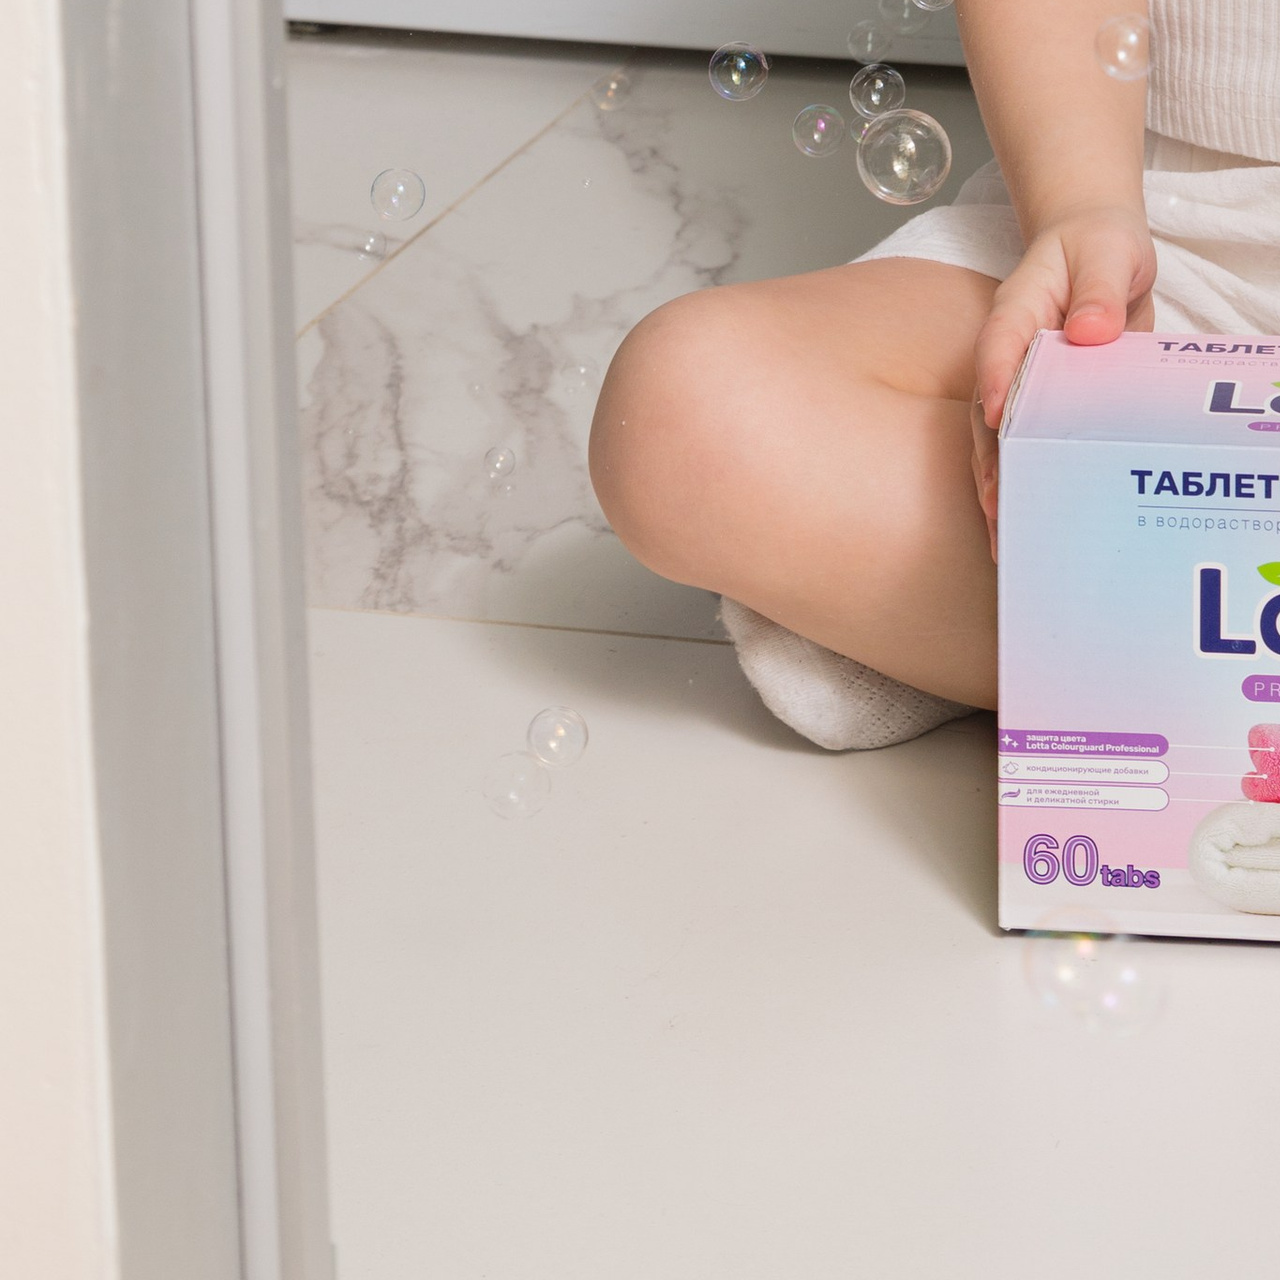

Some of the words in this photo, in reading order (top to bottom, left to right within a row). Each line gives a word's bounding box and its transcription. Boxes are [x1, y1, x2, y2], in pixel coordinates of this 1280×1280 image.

[1137, 516, 1147, 527] в
[1026, 735, 1059, 743] защита
[1060, 735, 1087, 744] цвета
[1051, 743, 1104, 753] Colourguard
[1105, 745, 1160, 754] Professional
[1026, 765, 1112, 775] кондиционирующие
[1113, 767, 1149, 775] добавки
[1044, 789, 1100, 797] ежедневной
[1034, 797, 1087, 805] деликатной
